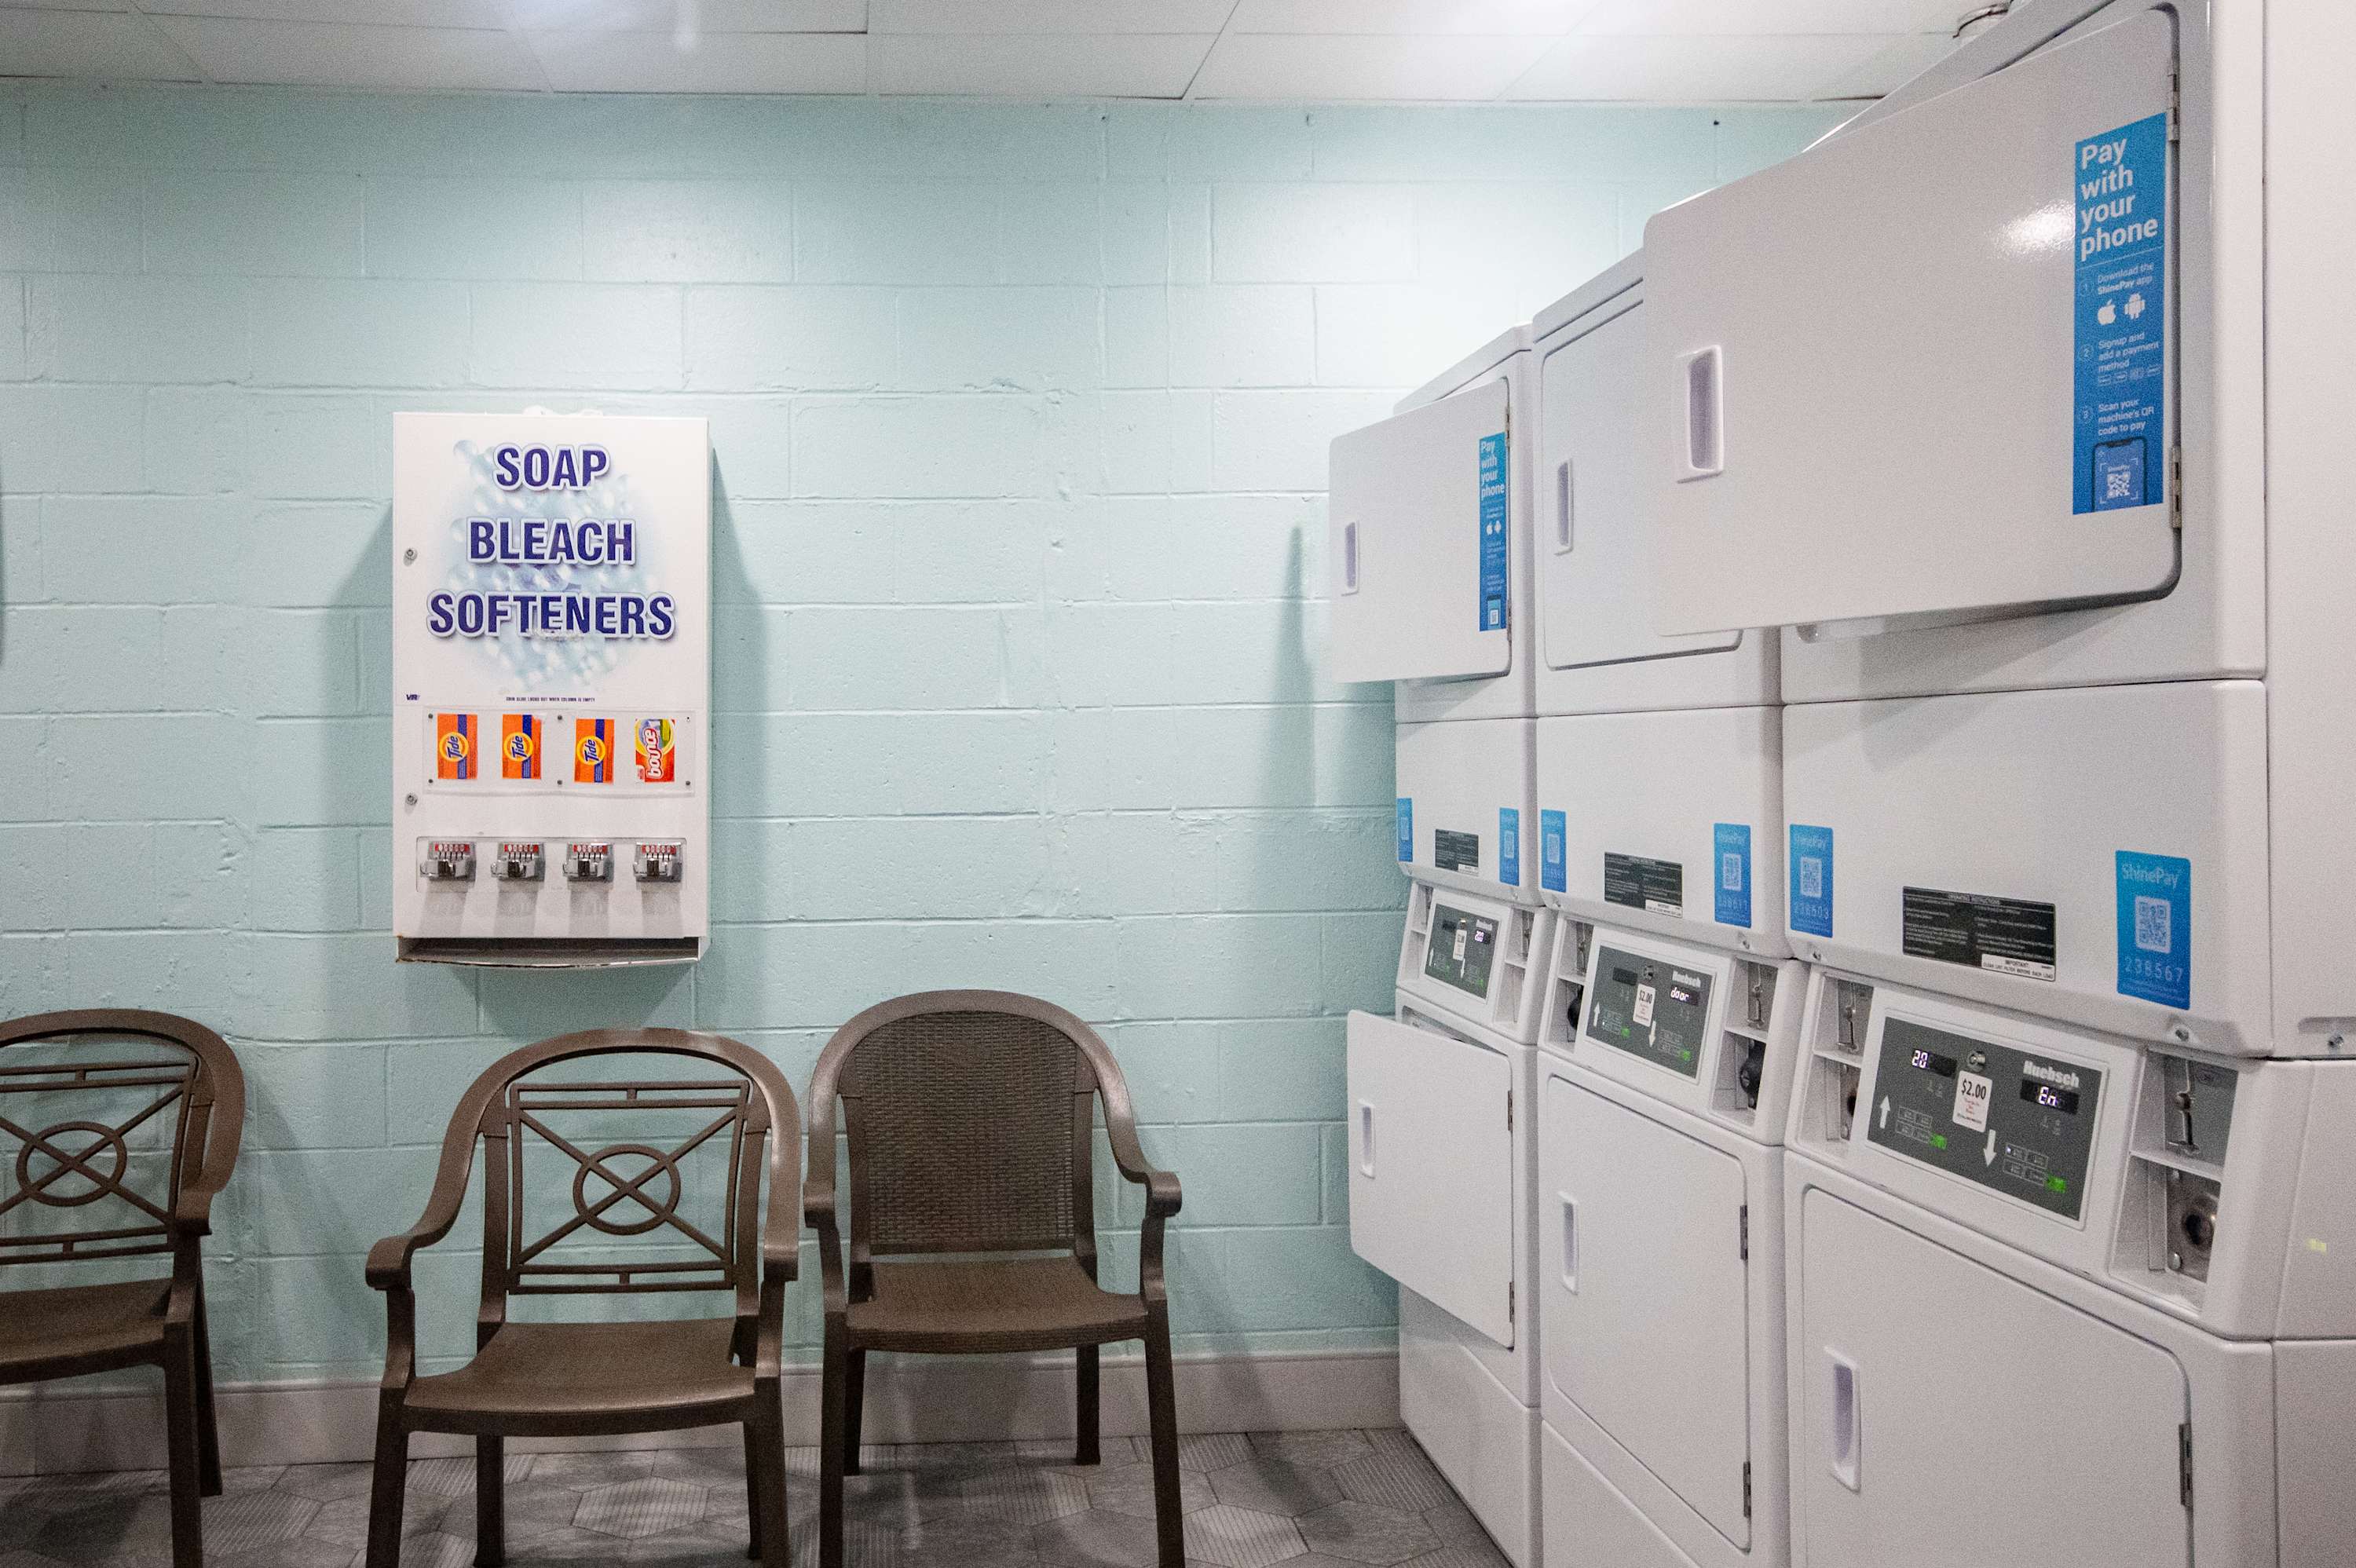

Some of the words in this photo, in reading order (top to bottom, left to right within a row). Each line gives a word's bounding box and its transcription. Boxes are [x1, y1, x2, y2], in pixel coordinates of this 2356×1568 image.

[2081, 138, 2127, 170] Pay
[2081, 164, 2134, 200] with
[2081, 195, 2136, 234] your
[2081, 218, 2158, 261] phone
[2098, 266, 2138, 283] Download
[2140, 263, 2153, 272] the
[2136, 276, 2153, 286] app
[2128, 332, 2145, 342] and
[2098, 350, 2114, 361] add
[2123, 342, 2159, 356] payment
[2098, 359, 2130, 372] method
[2098, 402, 2119, 412] Scan
[2120, 399, 2139, 410] your
[2098, 409, 2139, 423] machine's
[2141, 406, 2154, 416] QR
[2098, 425, 2118, 436] code
[2120, 423, 2128, 432] to
[2130, 421, 2146, 432] pay
[1481, 440, 1495, 454] Pay
[495, 445, 609, 488] SOAP
[1481, 455, 1497, 469] with
[1481, 470, 1498, 486] your
[1481, 484, 1505, 501] phone
[469, 519, 635, 563] BLEACH
[429, 592, 674, 637] SOFTENERS
[447, 735, 463, 758] Tide
[511, 735, 528, 758] Tide
[584, 739, 600, 762] Tide
[644, 727, 663, 779] bounce
[2122, 863, 2179, 890] ShinePay
[1911, 1049, 1928, 1069] 20
[2022, 1060, 2079, 1088] Huebsch
[1961, 1078, 1987, 1099] $2.00
